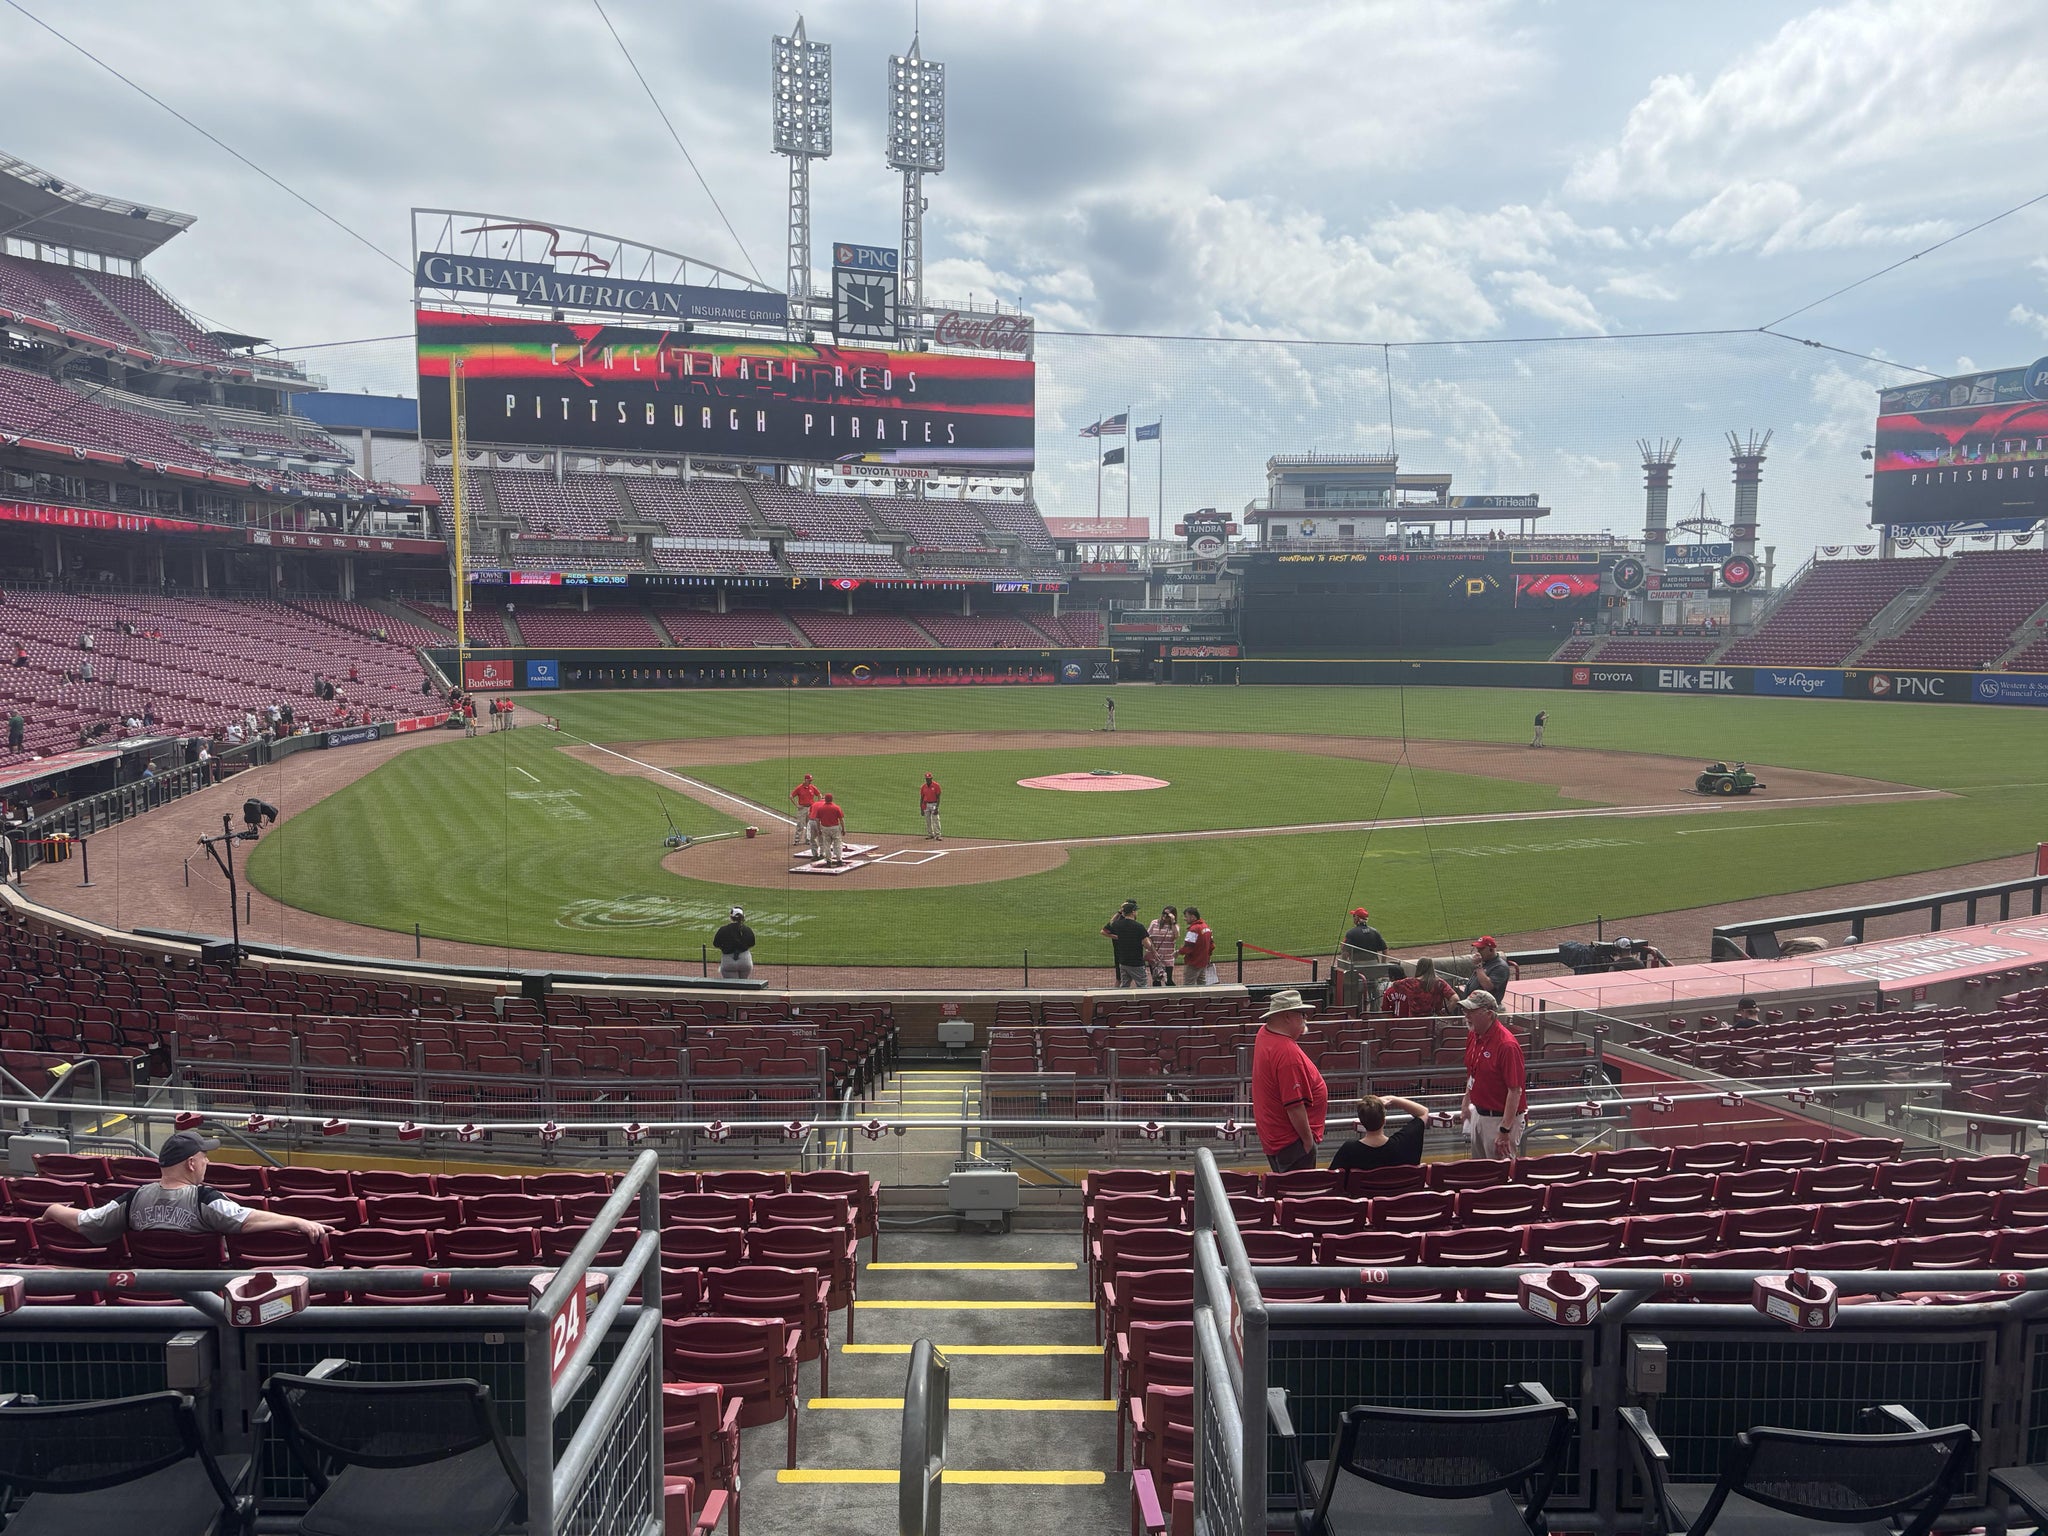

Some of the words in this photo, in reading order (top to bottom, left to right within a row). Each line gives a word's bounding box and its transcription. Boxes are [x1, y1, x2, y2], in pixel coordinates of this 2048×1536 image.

[856, 247, 896, 268] PNC
[424, 257, 534, 291] GREAT
[525, 275, 682, 313] AMERICAN
[691, 305, 747, 319] INSURANCE
[749, 310, 781, 322] GROUP
[551, 343, 796, 384] CINCINNATI
[835, 366, 916, 392] REDS
[506, 394, 765, 432] PITTSBURGH
[804, 413, 955, 444] PIRATES
[854, 466, 891, 477] TOYOTA
[892, 468, 930, 479] TUNDRA
[1494, 497, 1537, 507] TriHealth
[15, 504, 106, 527] CINCINNATI
[1187, 525, 1223, 533] TUNDRA
[1890, 524, 1946, 538] BEACON
[1199, 543, 1222, 551] REDS
[1689, 545, 1720, 557] PNC
[1278, 554, 1316, 562] COUNTDOWN
[1318, 554, 1325, 562] TO
[1328, 554, 1348, 562] FIRST
[479, 571, 503, 579] TOWNE
[593, 576, 626, 584] $20,180
[645, 577, 715, 586] PITTSBURGH
[724, 578, 769, 587] PIRATES
[576, 669, 684, 680] PITTSBURGH
[699, 669, 768, 679] PIRATES
[1593, 672, 1633, 682] TOYOTA
[1658, 669, 1734, 690] Elk+Elk
[468, 677, 512, 687] Budweiser
[1789, 672, 1826, 693] Kroger
[1896, 677, 1945, 696] PNC
[2001, 689, 2032, 697] Financial
[1809, 949, 1903, 968] WORLD
[1882, 937, 1970, 956] SERIES
[1846, 944, 2032, 982] CHAMPIONS
[115, 1273, 129, 1287] 2
[432, 1274, 441, 1288] 1
[1366, 1269, 1385, 1283] 10
[1672, 1273, 1684, 1287] 9
[2007, 1274, 2019, 1287] 8
[553, 1292, 580, 1372] 24
[1649, 1364, 1656, 1372] 9
